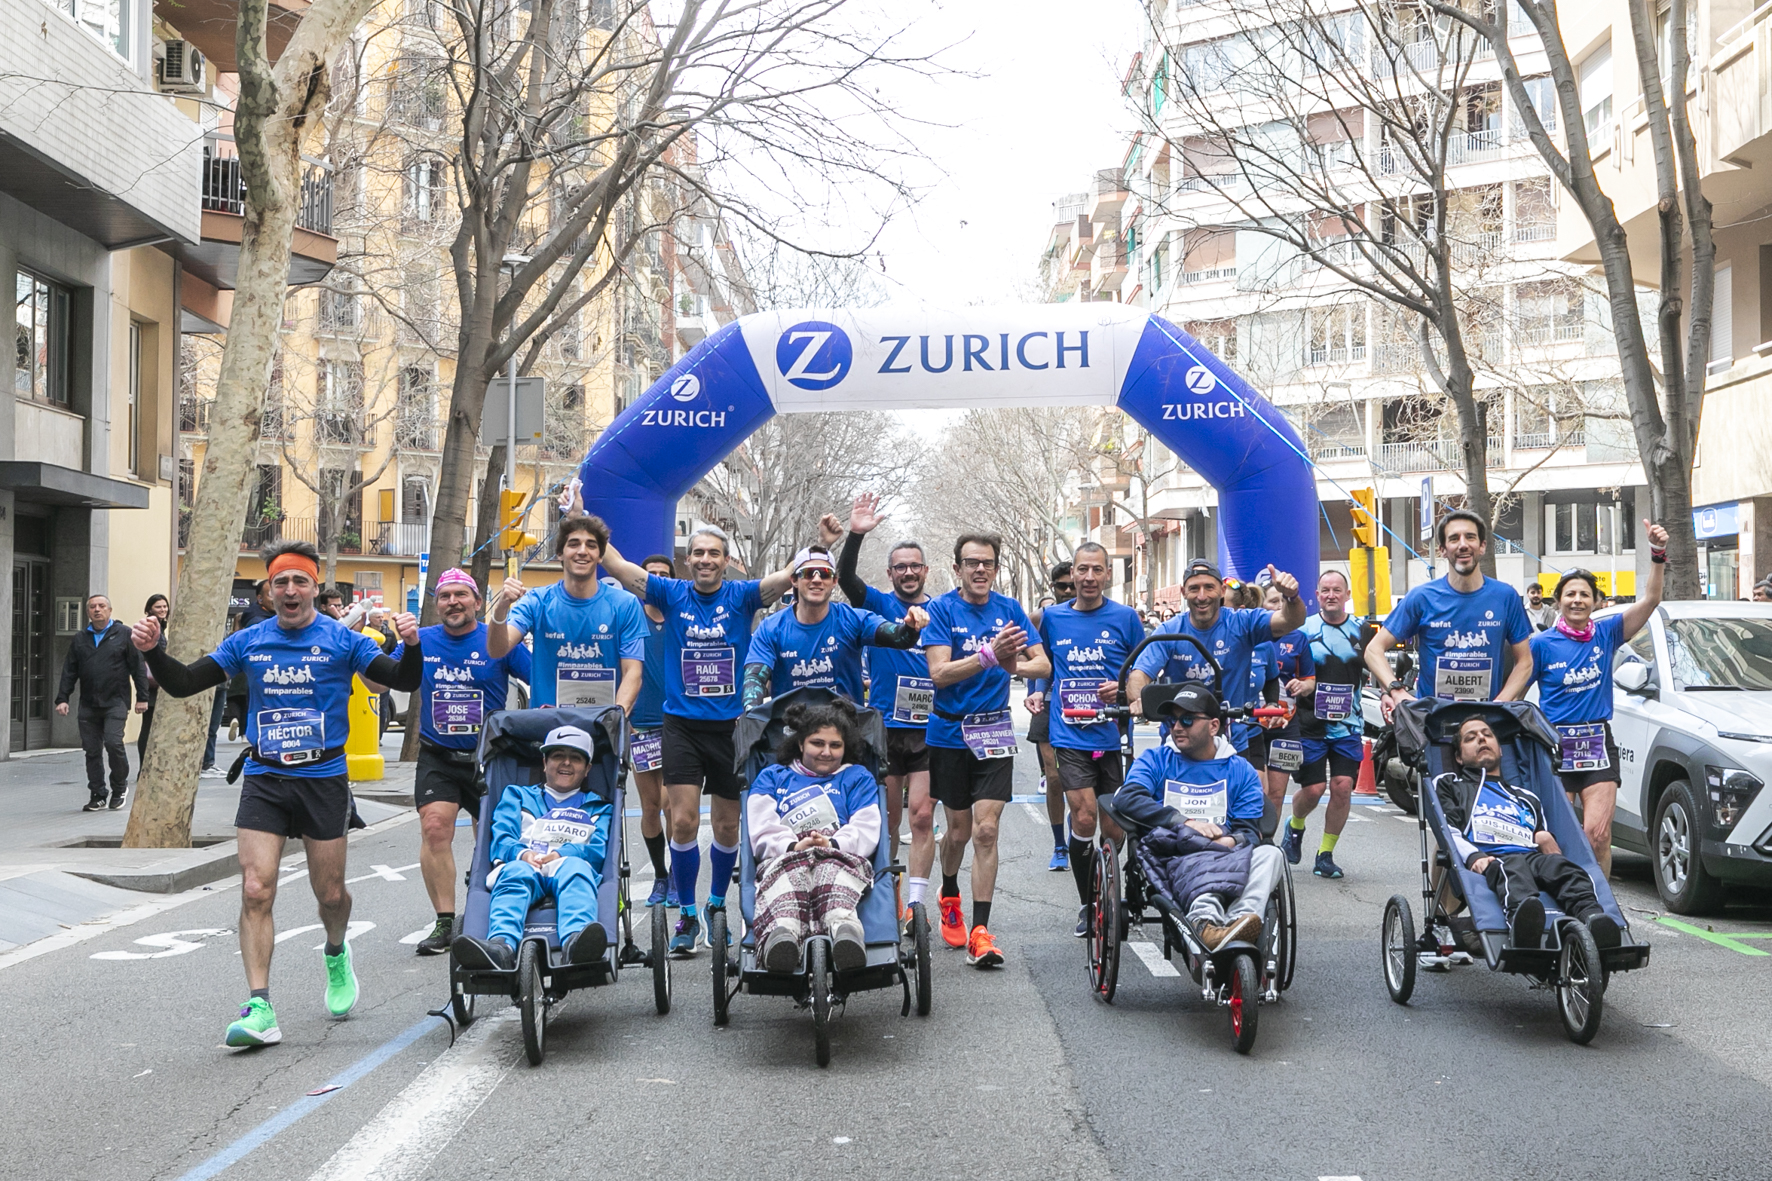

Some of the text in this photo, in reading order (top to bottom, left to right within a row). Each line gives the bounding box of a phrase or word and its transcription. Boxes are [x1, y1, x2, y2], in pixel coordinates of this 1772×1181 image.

[877, 330, 1090, 374] ZURICH
[1161, 401, 1246, 421] ZURICH
[641, 410, 726, 428] ZURICH
[1422, 482, 1430, 523] P
[229, 595, 250, 605] isos
[696, 663, 720, 674] RAÚL
[1445, 675, 1483, 686] ALBERT
[264, 688, 314, 696] #Imparables
[908, 693, 933, 703] MARC
[1068, 694, 1097, 703] OCHOA
[1325, 696, 1345, 704] ANDY
[445, 704, 469, 714] JOSE
[283, 711, 307, 719] ZURICH
[268, 725, 313, 740] HÉCTOR
[281, 740, 301, 749] 8004
[1278, 752, 1299, 761] BECKY
[788, 791, 811, 806] ZURICH
[560, 811, 583, 820] ZURICH
[789, 806, 817, 825] LOLA
[799, 818, 821, 832] 25248
